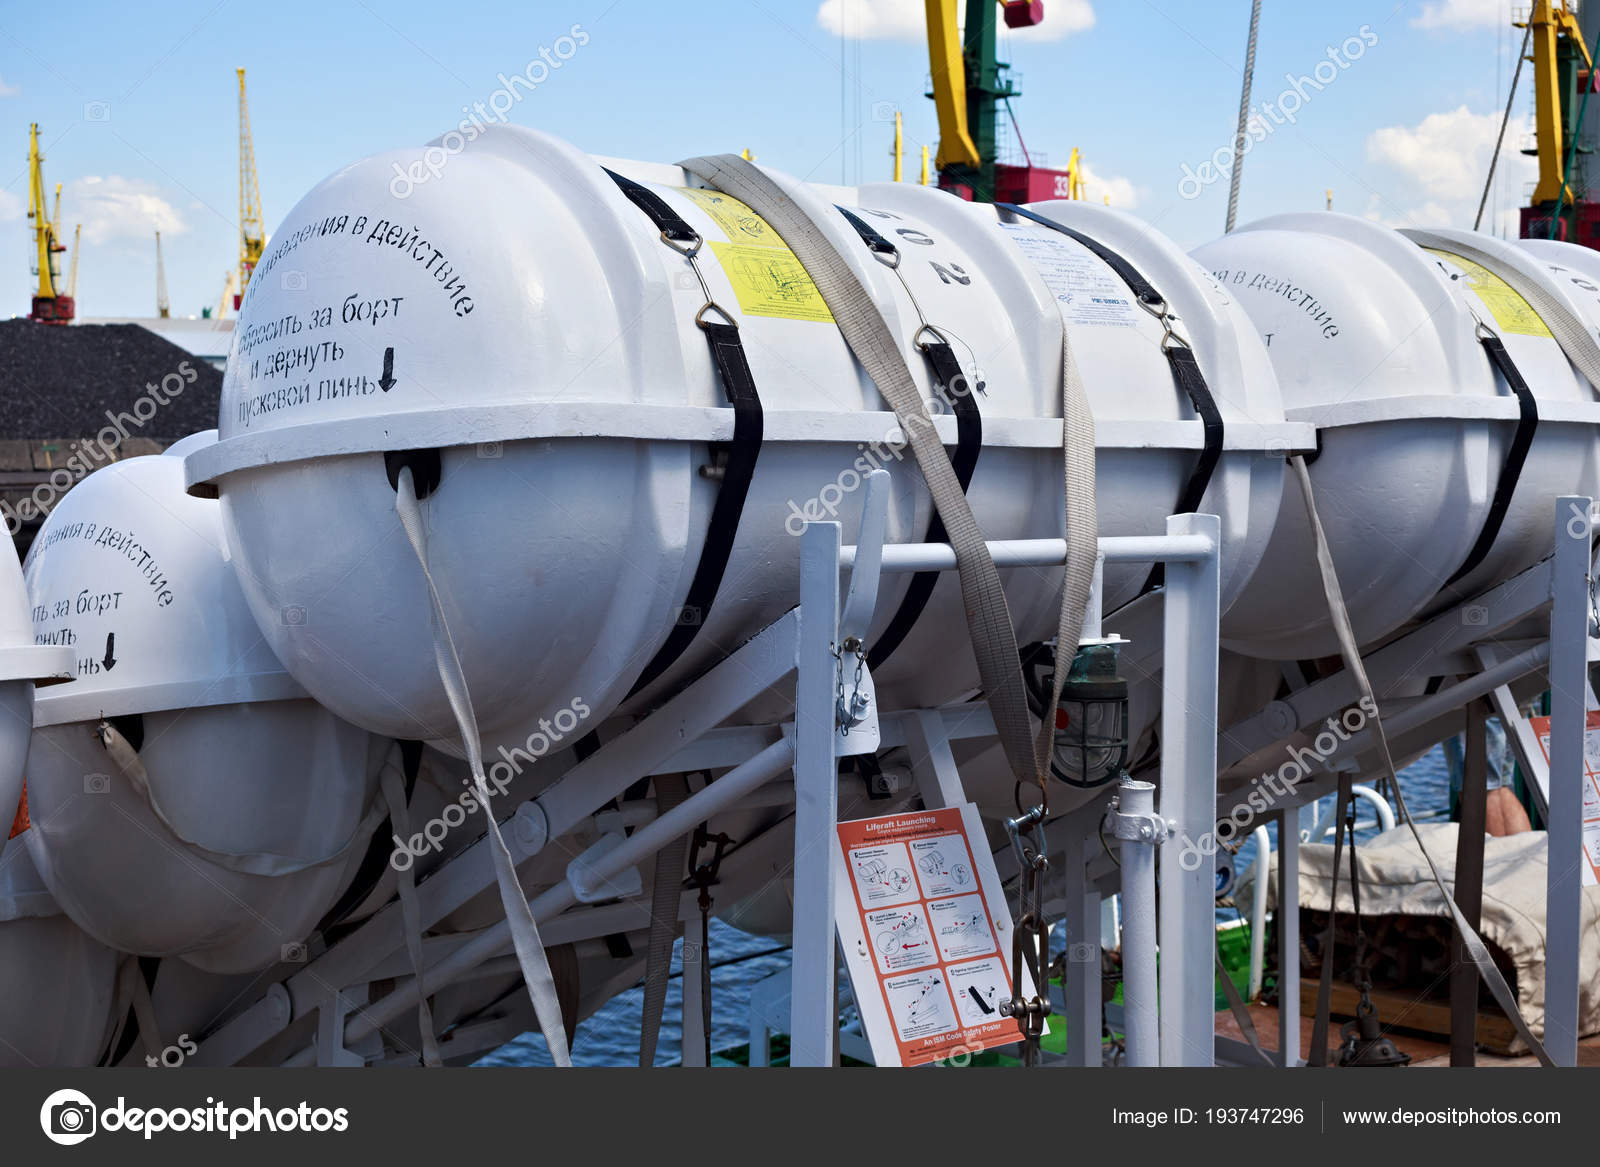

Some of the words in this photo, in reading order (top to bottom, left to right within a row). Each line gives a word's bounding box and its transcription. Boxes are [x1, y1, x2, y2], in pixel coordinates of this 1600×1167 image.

[1054, 175, 1068, 197] 33
[352, 215, 367, 235] в
[366, 219, 474, 318] действие
[309, 306, 332, 331] за
[342, 293, 404, 326] борт
[1248, 273, 1339, 340] действие
[250, 358, 259, 380] и
[264, 341, 344, 380] дёрнуть
[238, 378, 310, 427] пусковой
[317, 375, 376, 402] линь
[84, 523, 97, 540] в
[95, 526, 174, 608] действие
[52, 599, 70, 619] за
[76, 589, 124, 616] борт
[865, 821, 895, 832] Liferaft
[896, 816, 937, 828] Launching
[946, 1032, 962, 1041] Code
